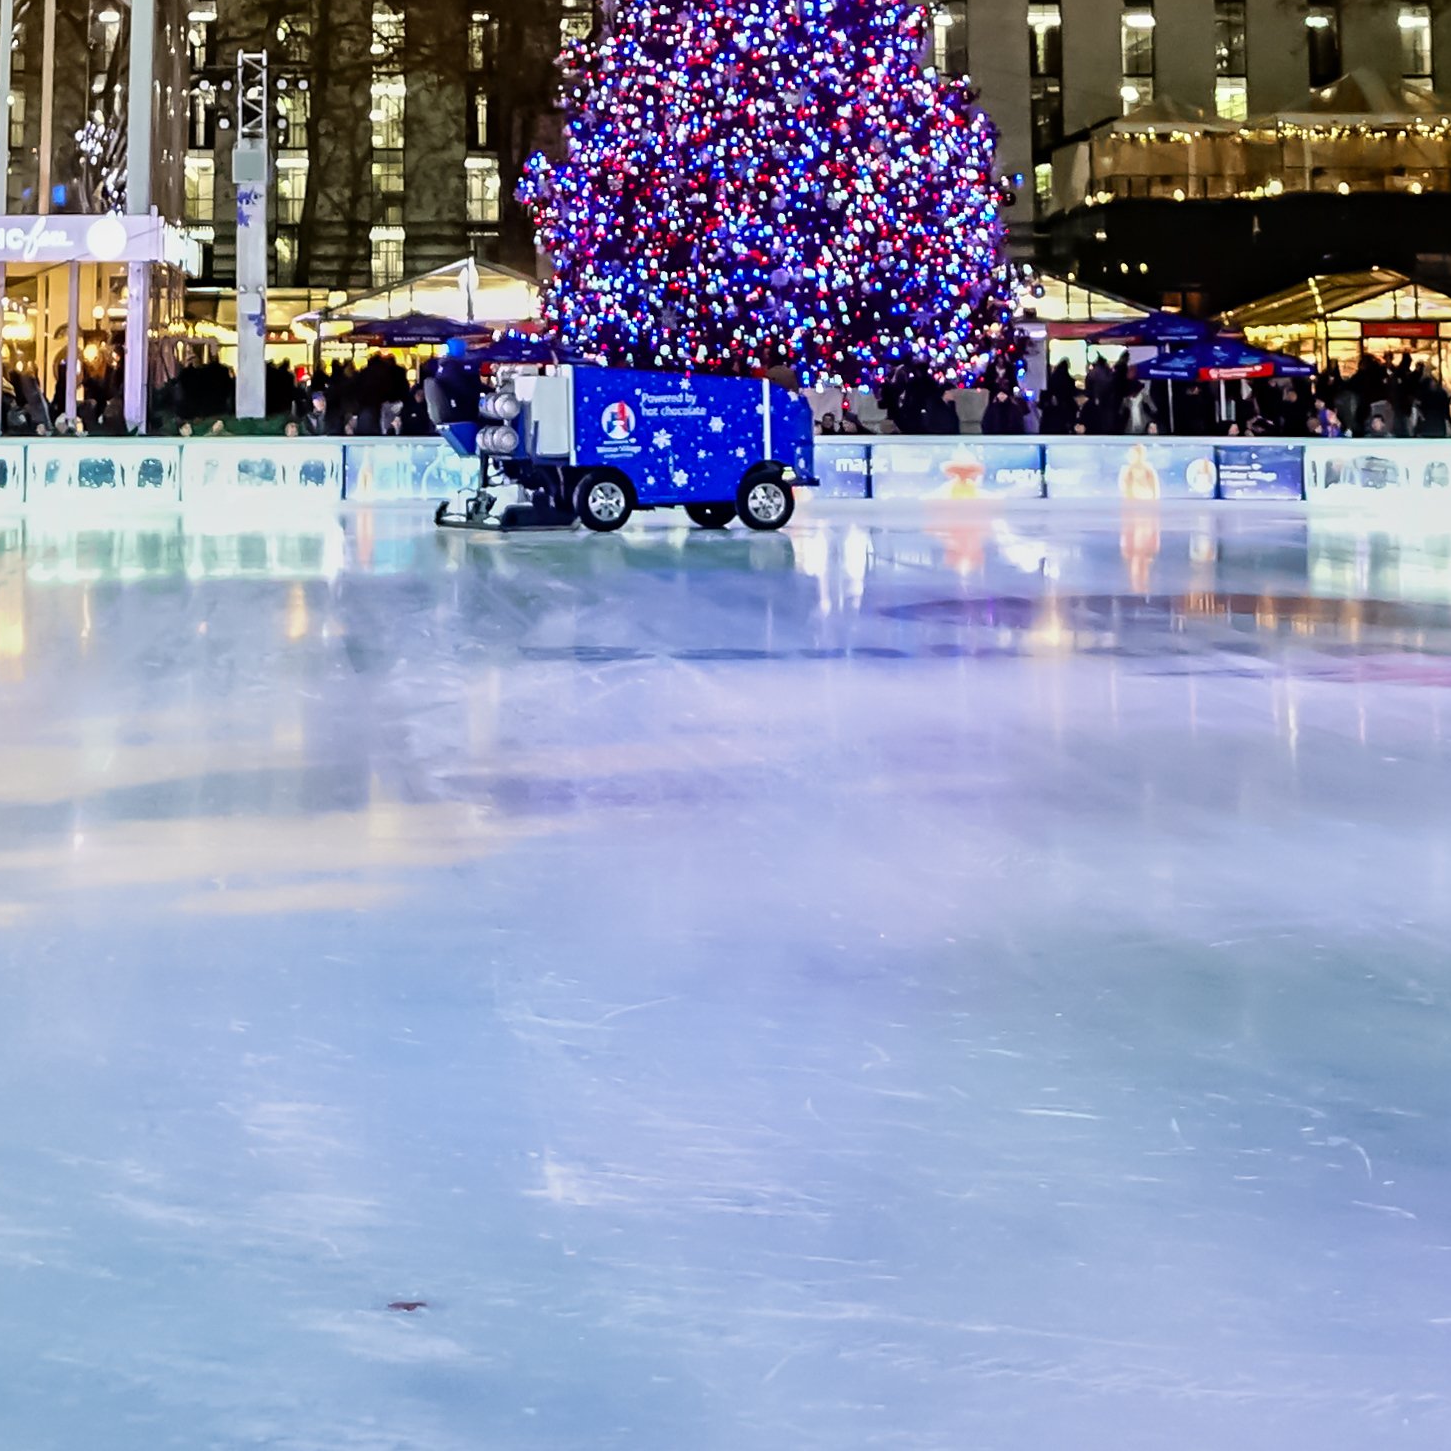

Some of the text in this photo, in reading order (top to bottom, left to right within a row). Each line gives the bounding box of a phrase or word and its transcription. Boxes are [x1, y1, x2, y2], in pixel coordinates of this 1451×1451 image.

[642, 393, 697, 405] Powered by
[642, 406, 707, 416] hot chocolate
